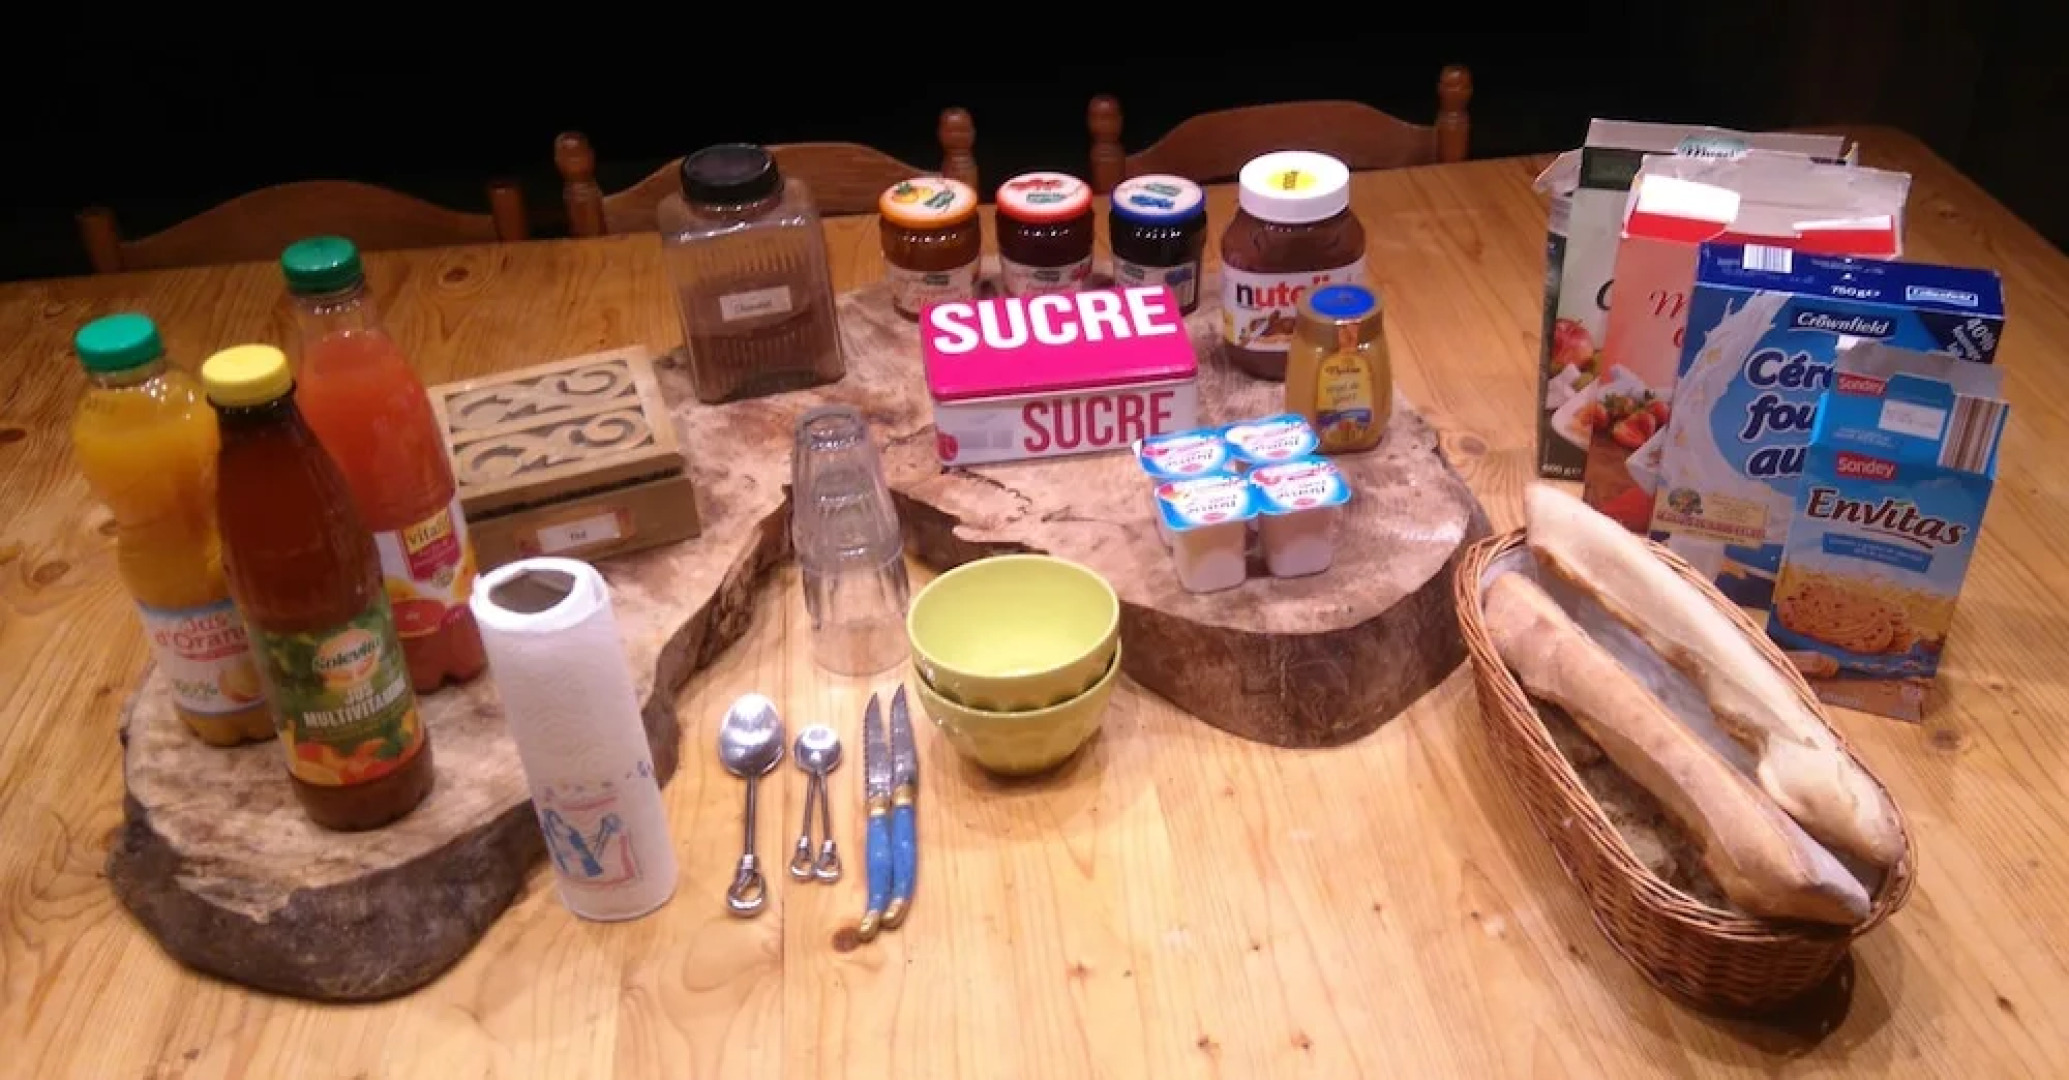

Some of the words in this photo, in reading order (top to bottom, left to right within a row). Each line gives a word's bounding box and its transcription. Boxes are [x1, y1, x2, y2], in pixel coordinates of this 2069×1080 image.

[1237, 275, 1331, 308] nute
[931, 286, 1177, 354] SUCRE
[1838, 374, 1885, 395] Sondey
[1022, 391, 1175, 452] SUCRE
[1838, 457, 1895, 480] Sondey
[1807, 487, 1968, 546] Envitas
